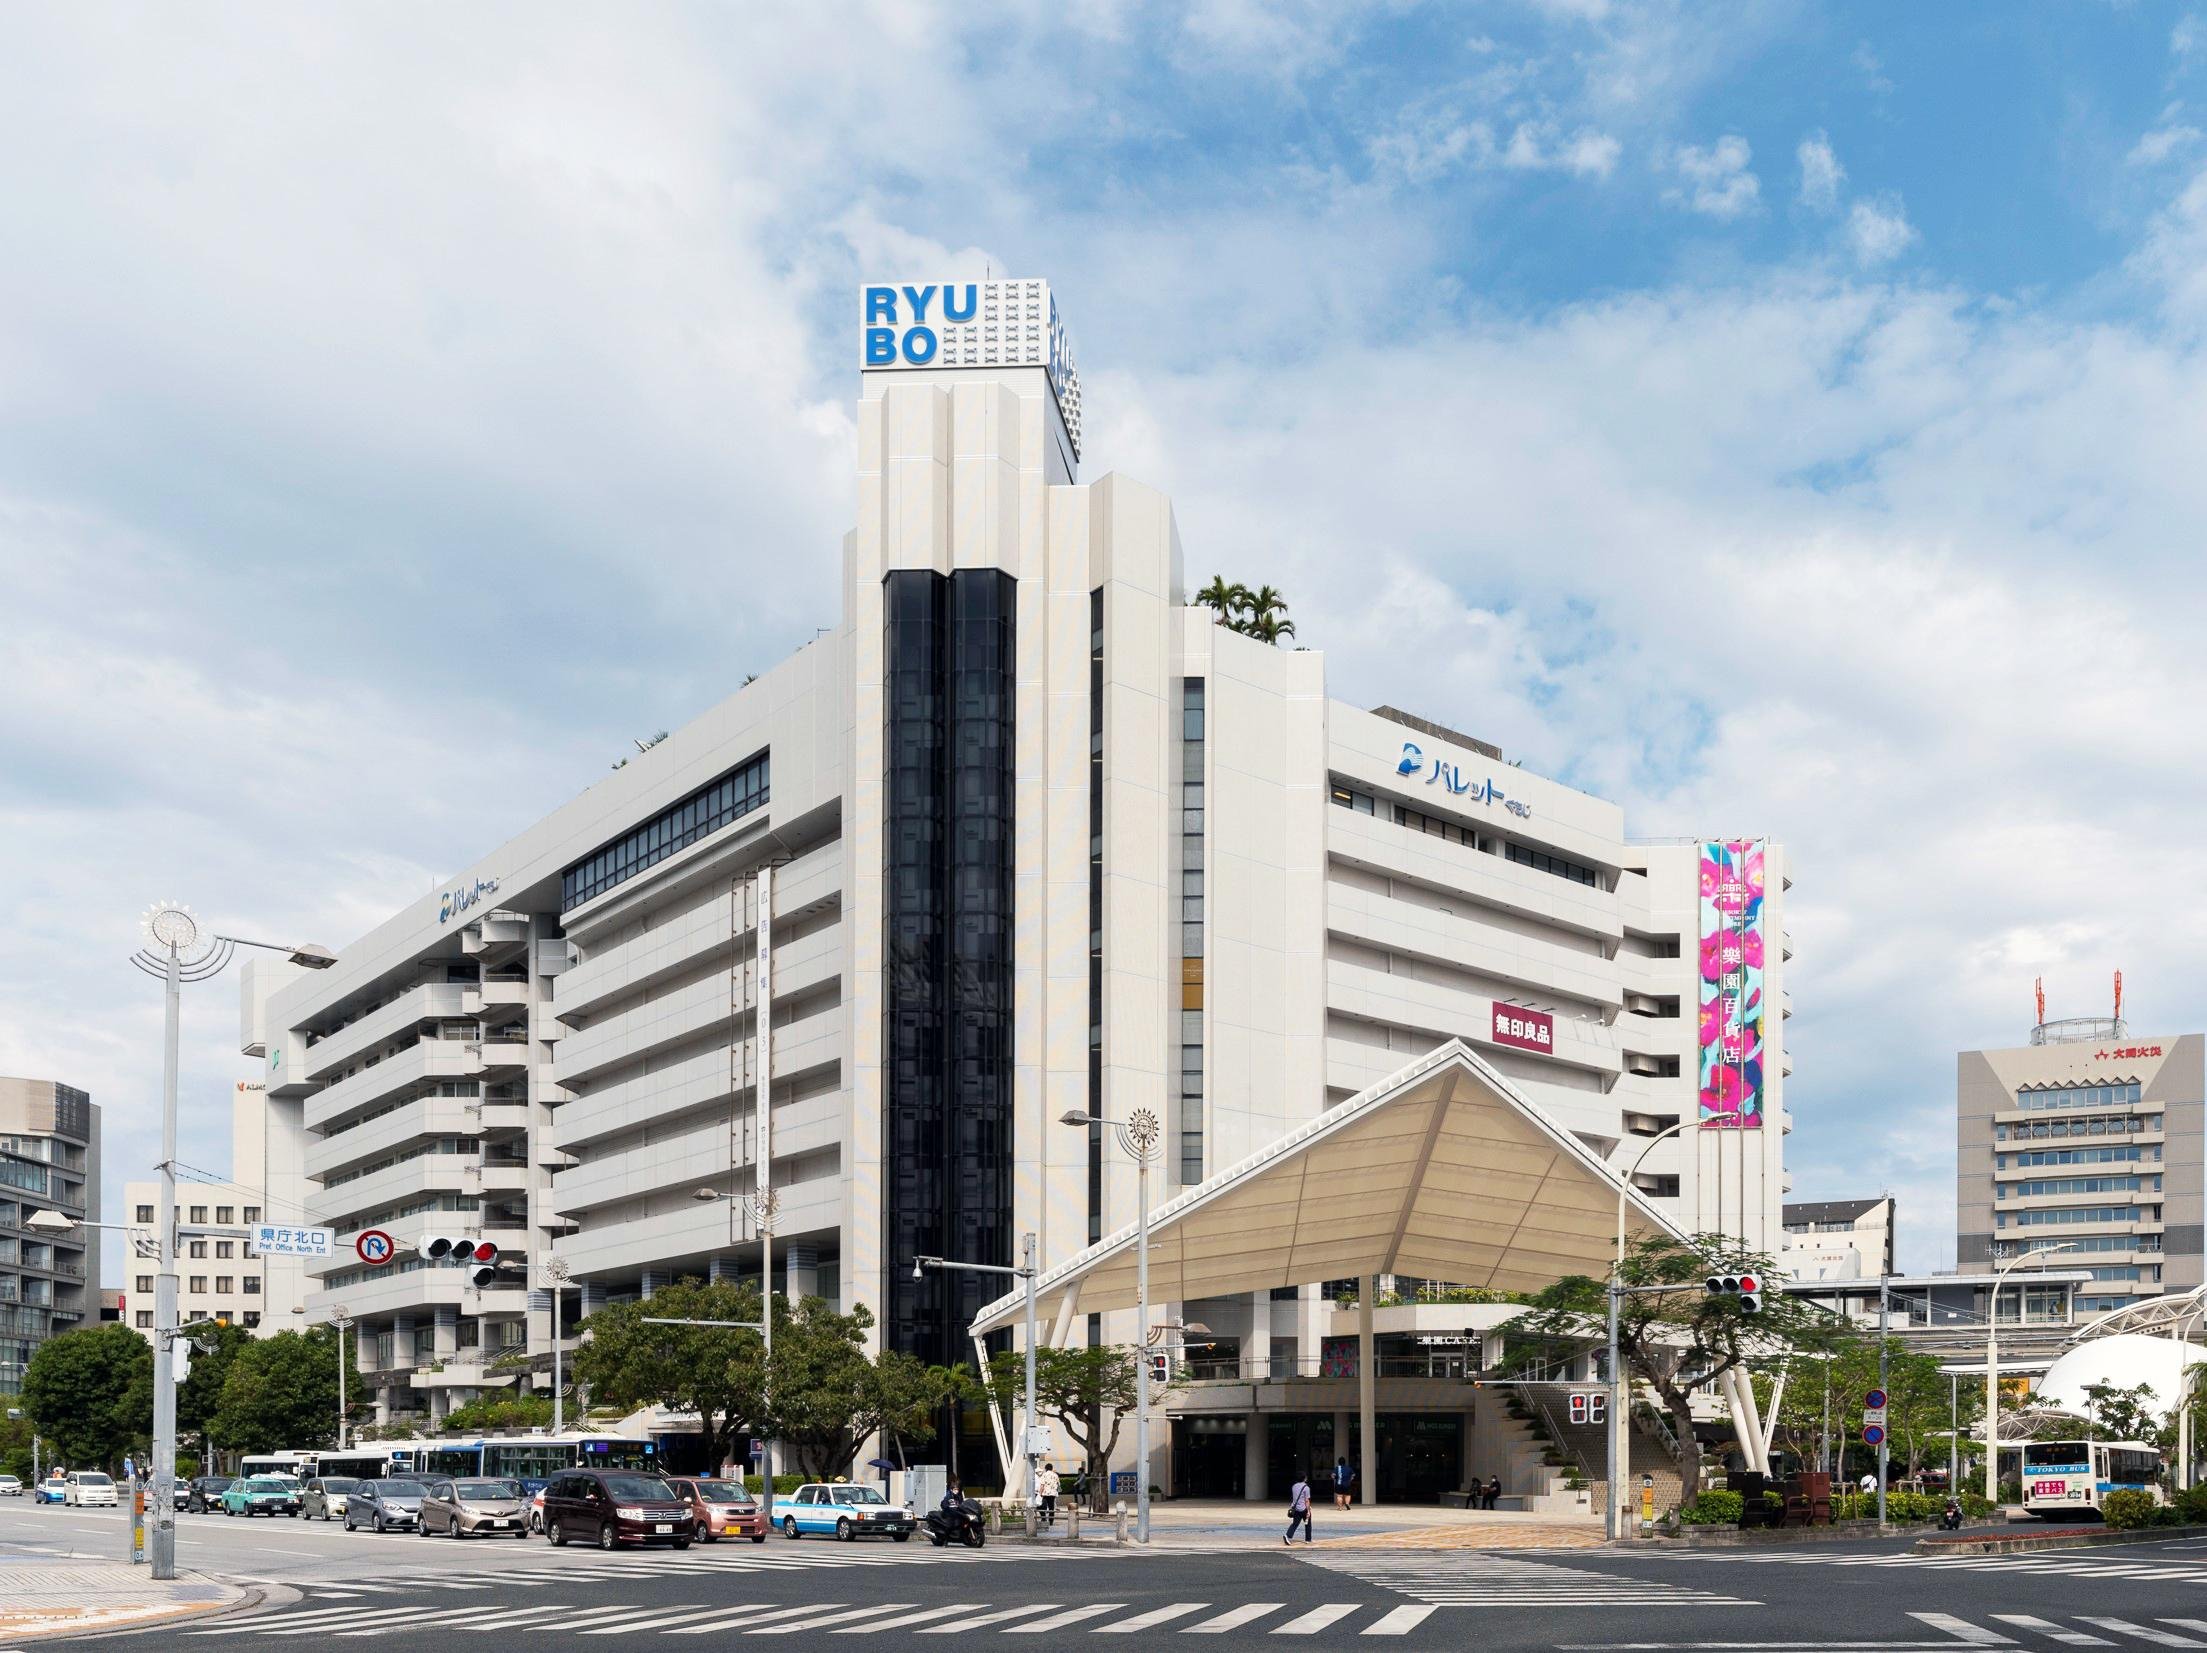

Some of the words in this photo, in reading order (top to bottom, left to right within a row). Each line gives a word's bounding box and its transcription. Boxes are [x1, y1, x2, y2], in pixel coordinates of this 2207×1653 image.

[866, 284, 977, 325] RYU
[866, 326, 938, 366] BO
[1496, 1013, 1550, 1045] 無印良品
[261, 1228, 324, 1244] 県庁北口
